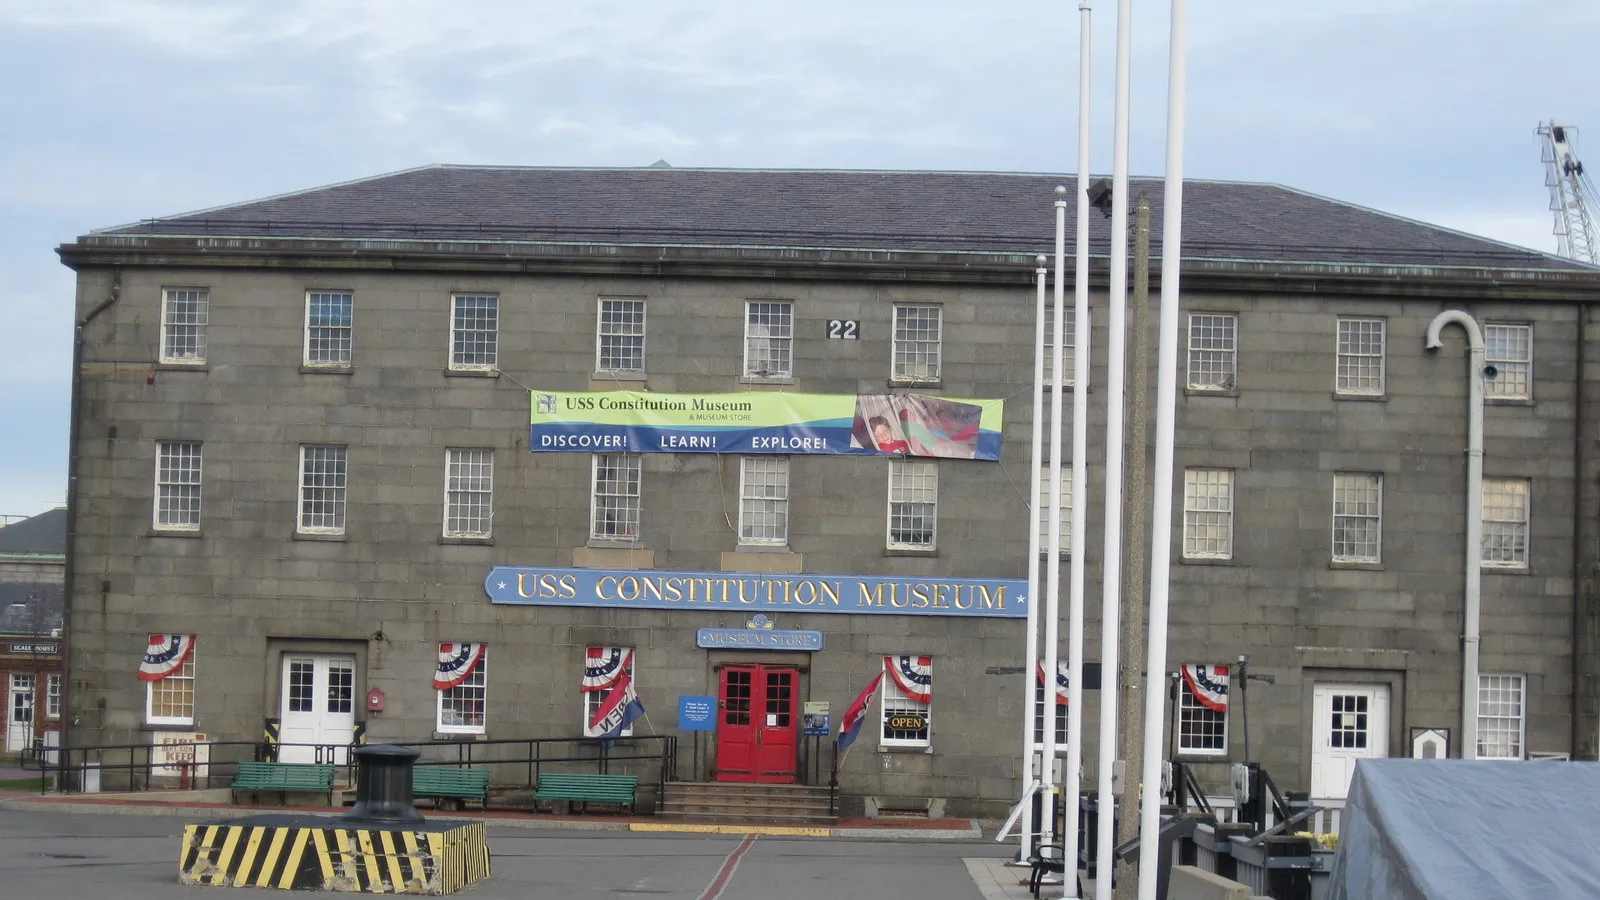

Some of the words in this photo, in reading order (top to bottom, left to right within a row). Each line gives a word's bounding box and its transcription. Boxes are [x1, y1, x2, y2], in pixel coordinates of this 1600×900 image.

[829, 319, 857, 339] 22
[565, 396, 595, 411] USS
[599, 396, 687, 411] Constitution
[691, 398, 753, 412] Museum
[689, 413, 696, 421] &
[697, 413, 729, 422] MUSEUM
[729, 414, 752, 422] STORE
[541, 434, 628, 448] DISCOVER!
[660, 435, 717, 449] LEARN!
[752, 436, 827, 450] EXPLORE!
[516, 573, 577, 599] USS
[595, 575, 844, 606] CONSTITUTION
[856, 580, 1008, 611] MUSEUM
[708, 632, 765, 646] MUSEUM
[769, 634, 812, 647] STORE
[891, 717, 922, 728] OPEN
